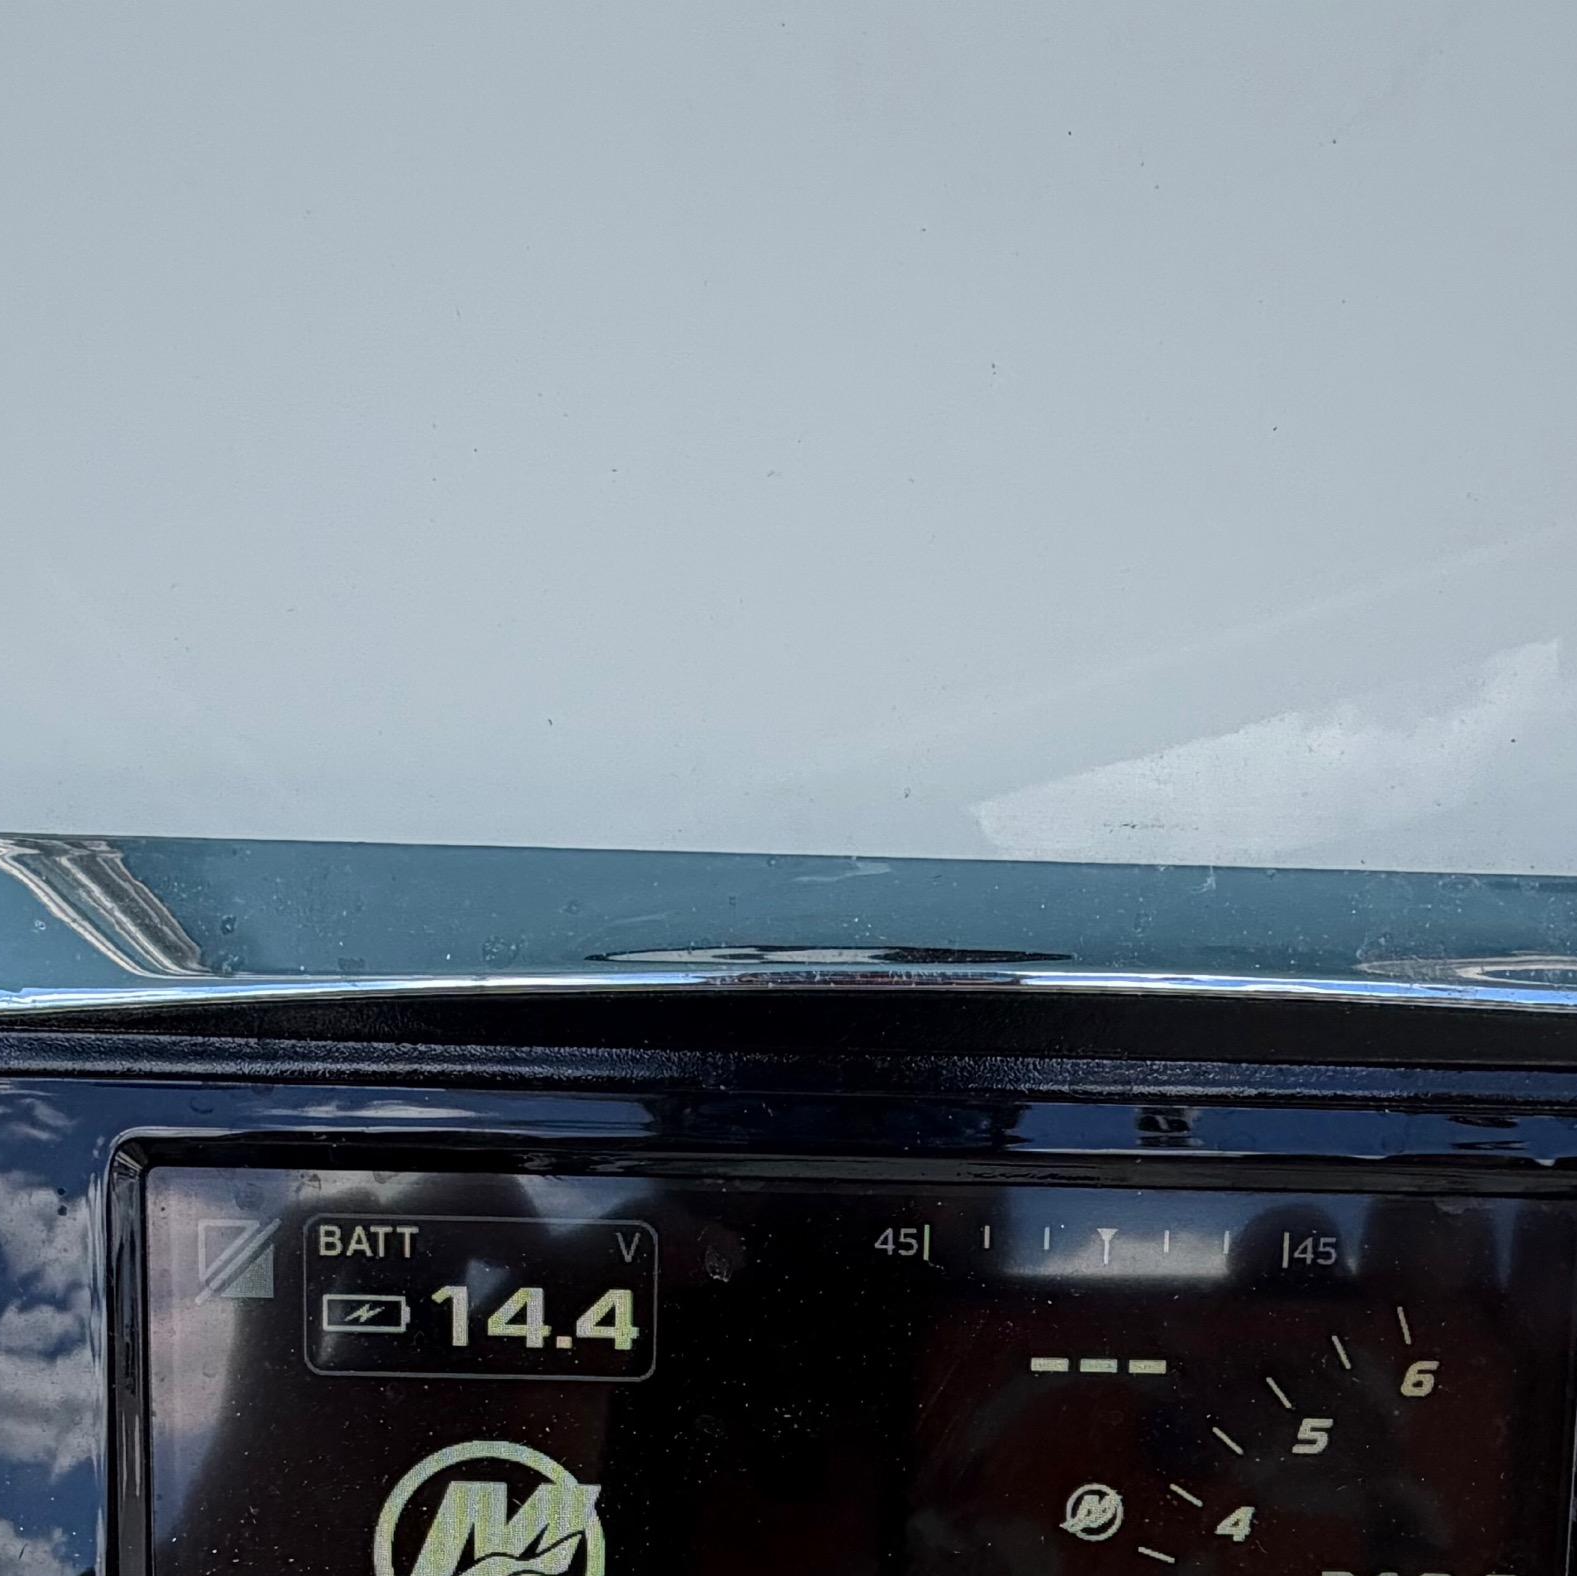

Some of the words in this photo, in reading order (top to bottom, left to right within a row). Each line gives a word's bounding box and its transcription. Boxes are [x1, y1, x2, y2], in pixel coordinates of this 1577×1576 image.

[319, 1225, 419, 1258] BATT
[617, 1232, 640, 1263] V
[874, 1228, 920, 1256] 45
[1293, 1238, 1338, 1264] 45
[431, 1285, 640, 1350] 14.4
[1400, 1360, 1438, 1397] 6
[1292, 1418, 1333, 1454] 5
[1214, 1506, 1255, 1541] 4
